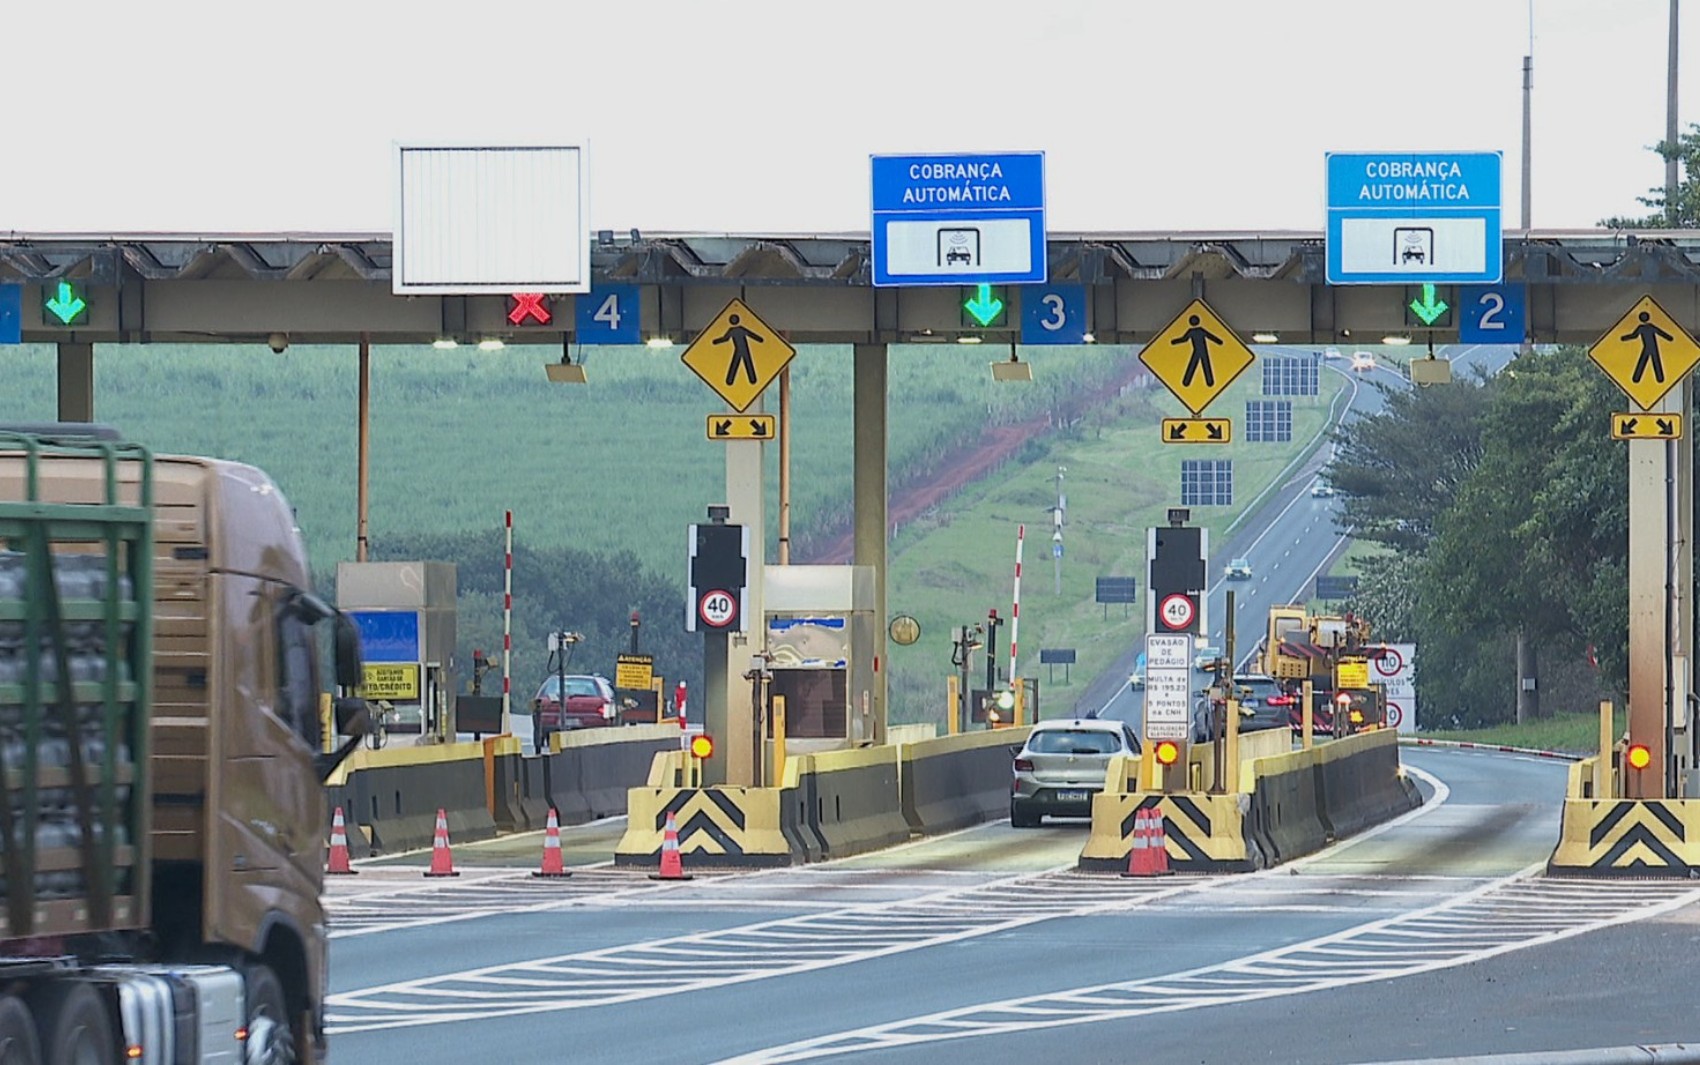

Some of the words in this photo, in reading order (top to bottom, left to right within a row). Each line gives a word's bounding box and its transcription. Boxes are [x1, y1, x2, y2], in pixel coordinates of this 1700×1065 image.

[909, 162, 1003, 181] COBRANÇA
[1366, 162, 1462, 180] COBRANÇA
[902, 180, 1011, 203] AUTOMÁTICA
[1358, 180, 1470, 200] AUTOMÁTICA
[593, 293, 621, 330] 4
[1041, 294, 1066, 330] 3
[1479, 292, 1505, 329] 2
[708, 597, 729, 613] 40
[1168, 604, 1187, 616] 40
[1150, 638, 1184, 646] EVASÃO
[1149, 657, 1185, 665] PEDÁGIO
[1161, 648, 1172, 656] DE
